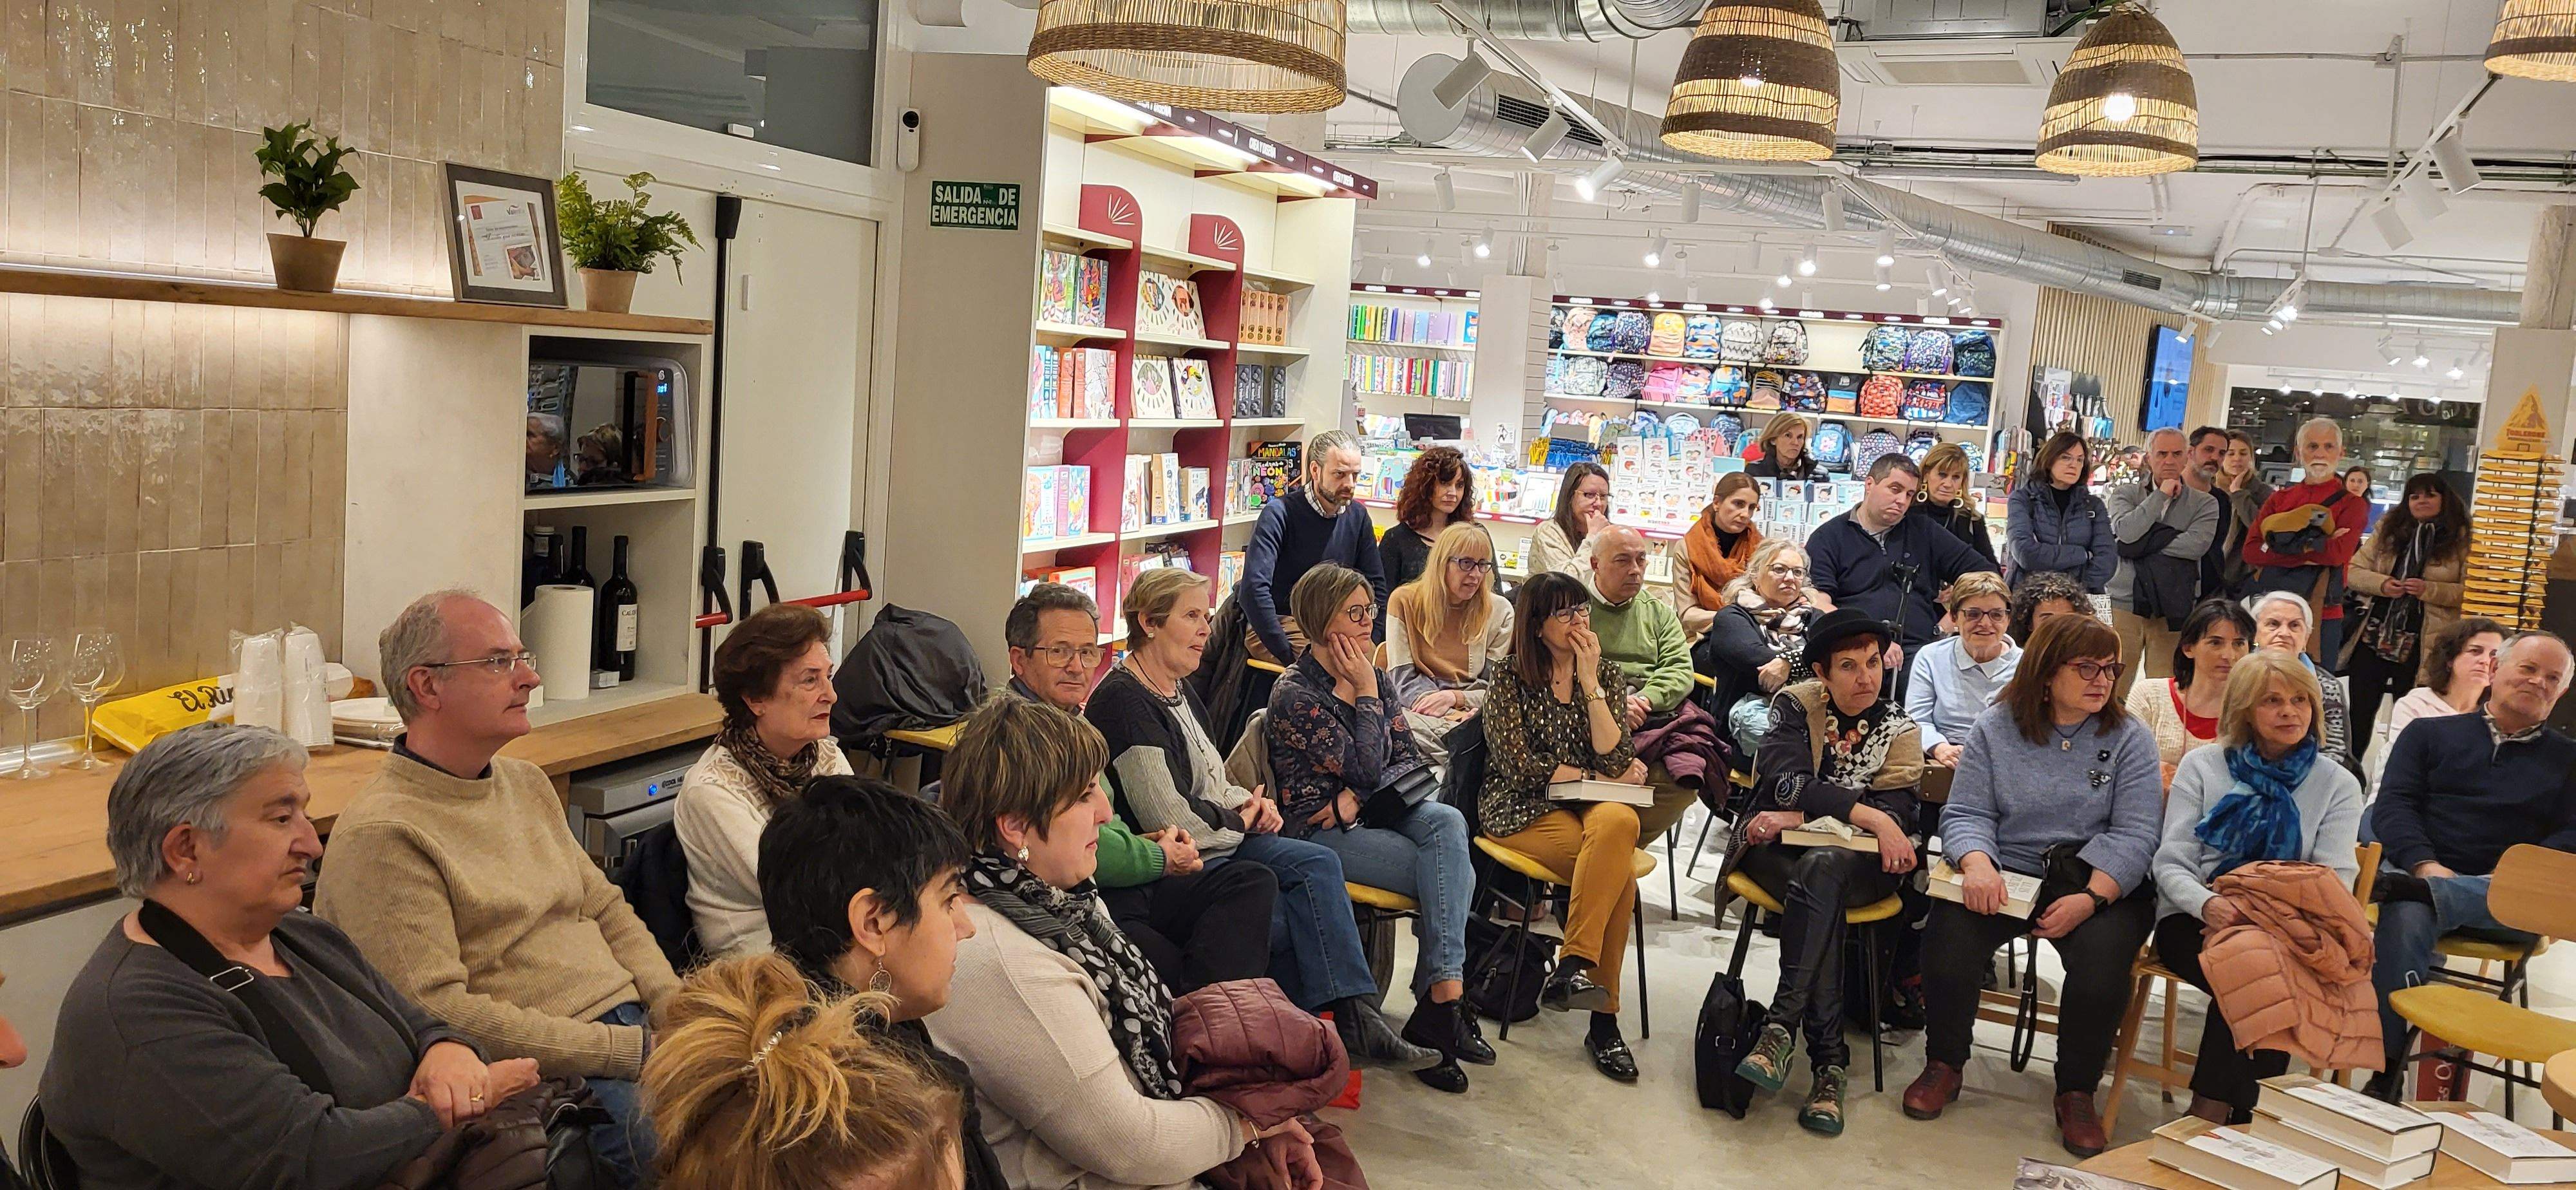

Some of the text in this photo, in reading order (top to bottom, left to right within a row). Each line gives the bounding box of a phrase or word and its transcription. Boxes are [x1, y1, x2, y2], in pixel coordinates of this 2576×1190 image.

[935, 185, 1016, 205] SALIDA DE
[932, 205, 1017, 225] EMERGENCIA
[1258, 447, 1296, 457] MANDALAS
[1253, 467, 1283, 477] NEON
